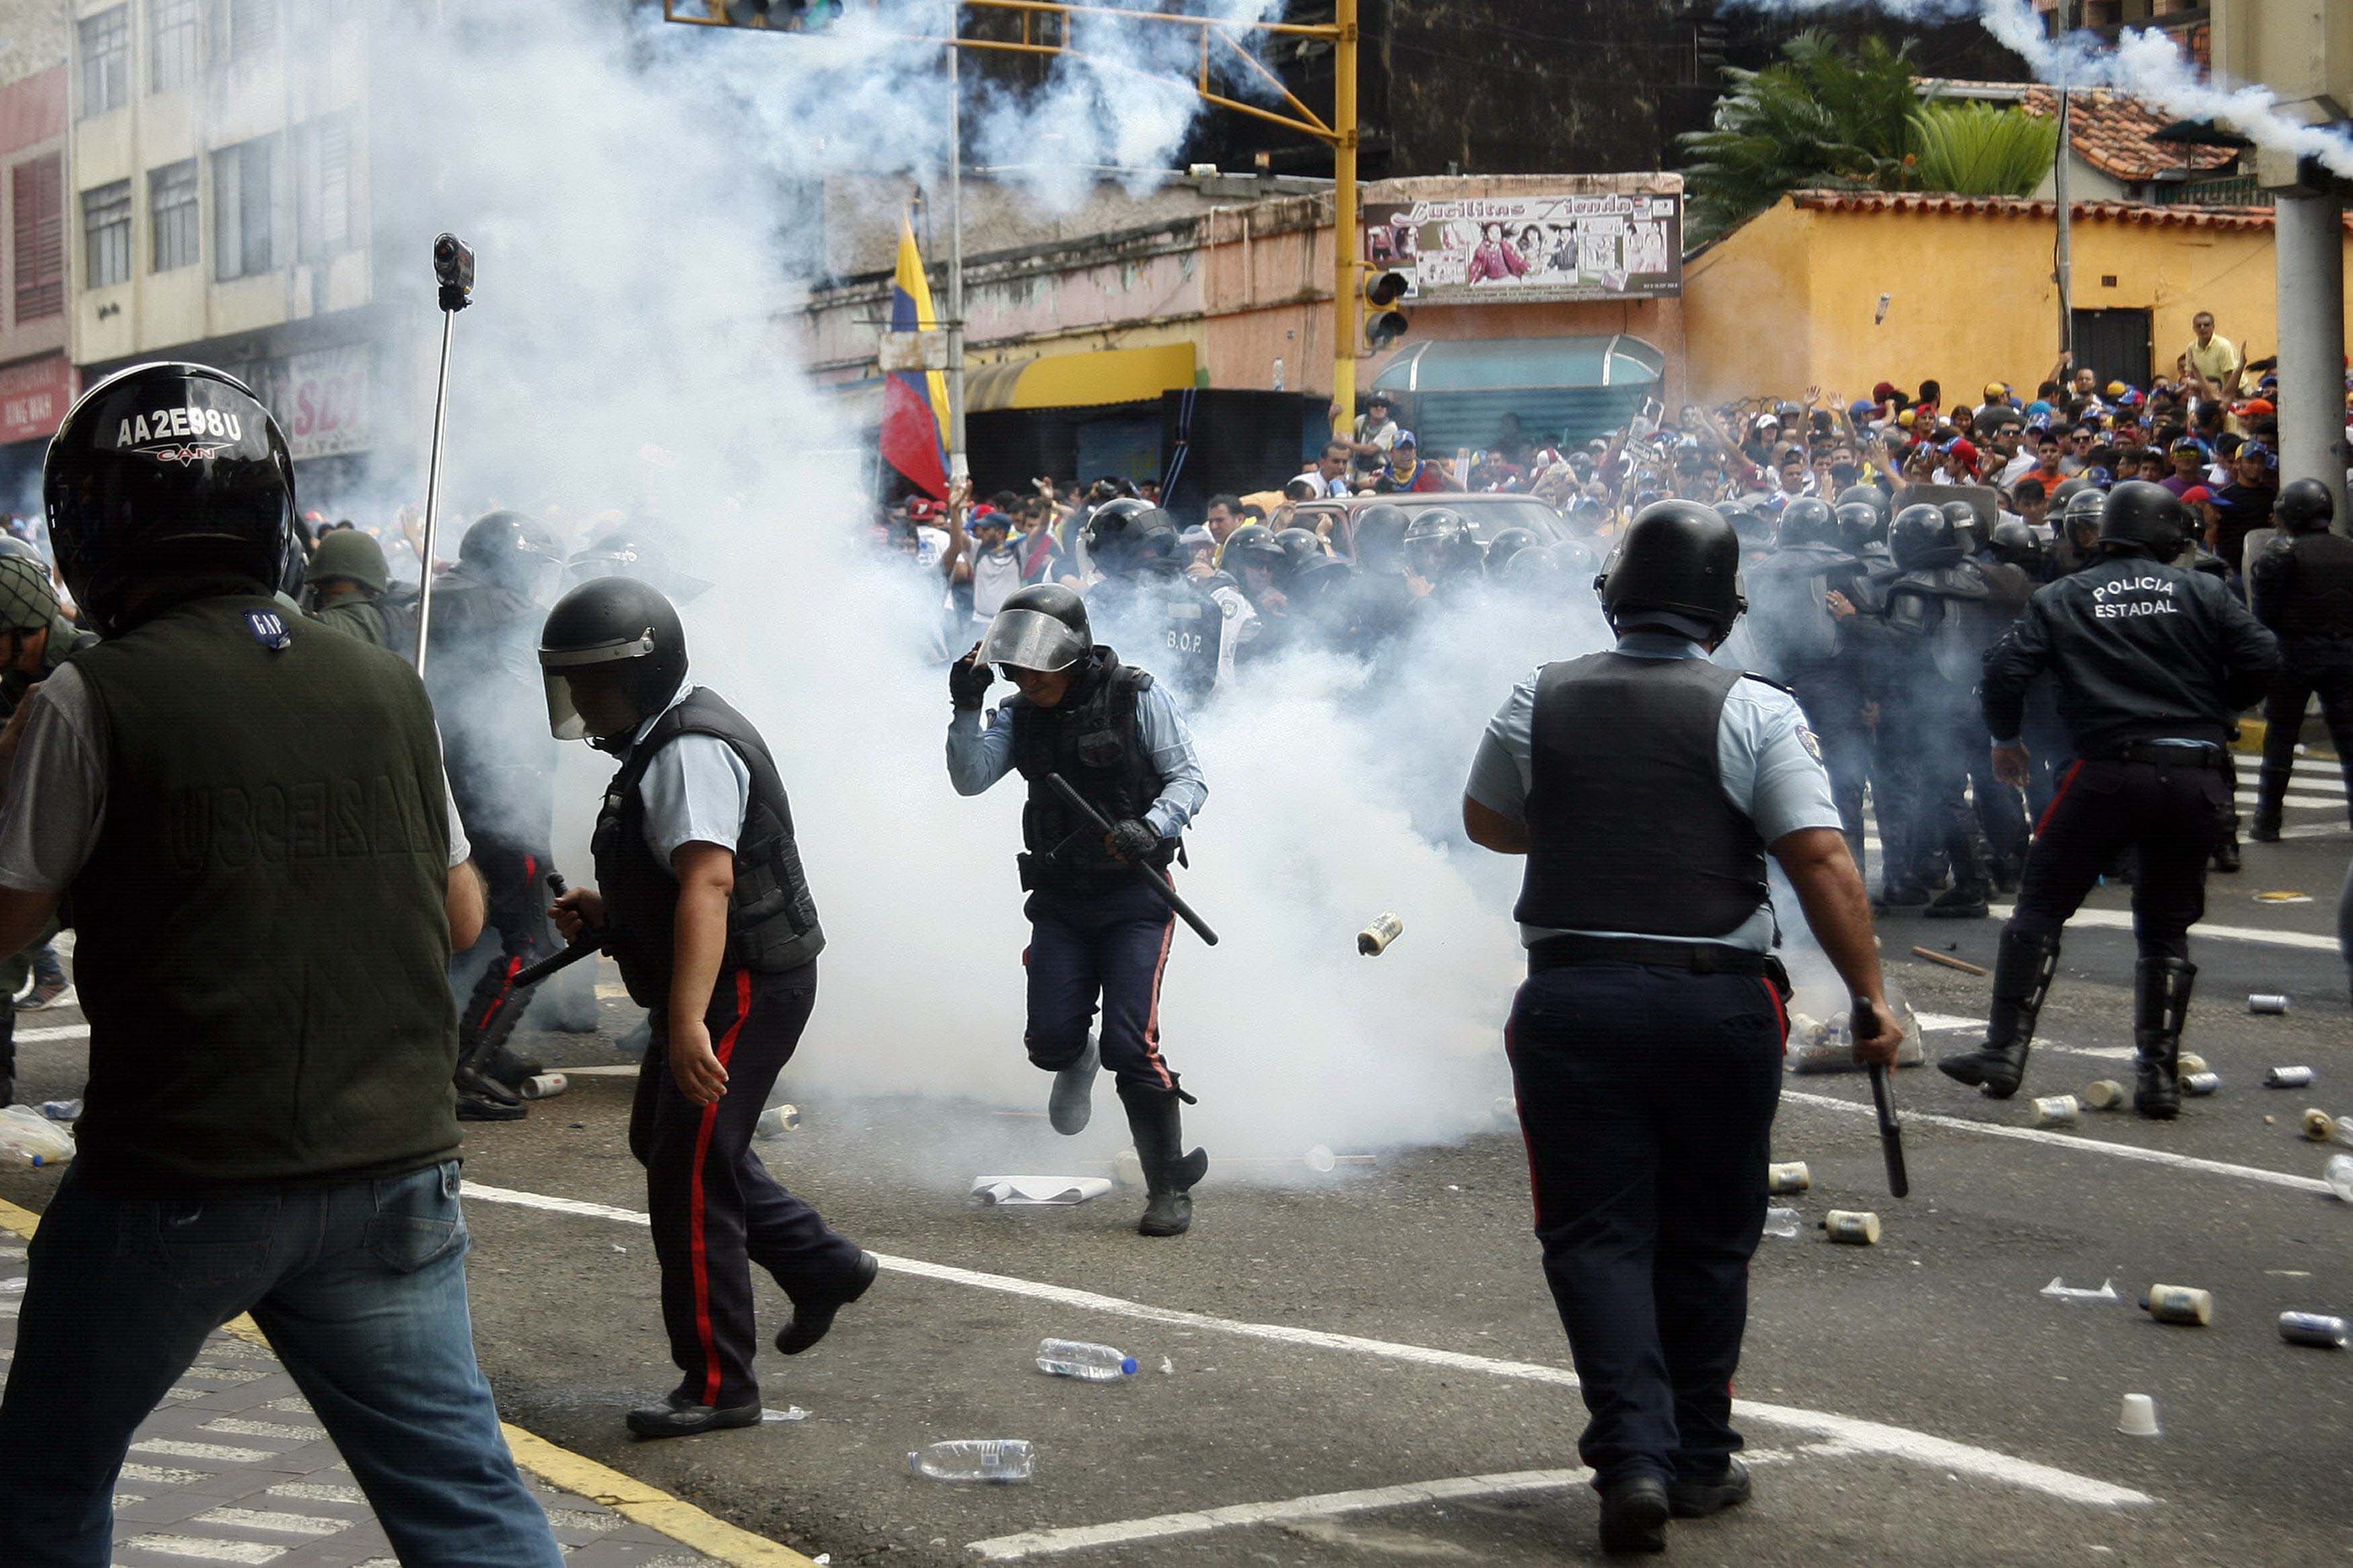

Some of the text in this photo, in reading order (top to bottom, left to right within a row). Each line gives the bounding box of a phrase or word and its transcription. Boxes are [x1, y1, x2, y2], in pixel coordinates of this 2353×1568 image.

[116, 407, 241, 448] AA2E98U
[157, 448, 215, 460] CAN
[2092, 577, 2173, 602] POLICIA
[2095, 600, 2178, 618] ESTADAL
[252, 614, 282, 634] GAP
[1167, 630, 1201, 654] B.O.P.
